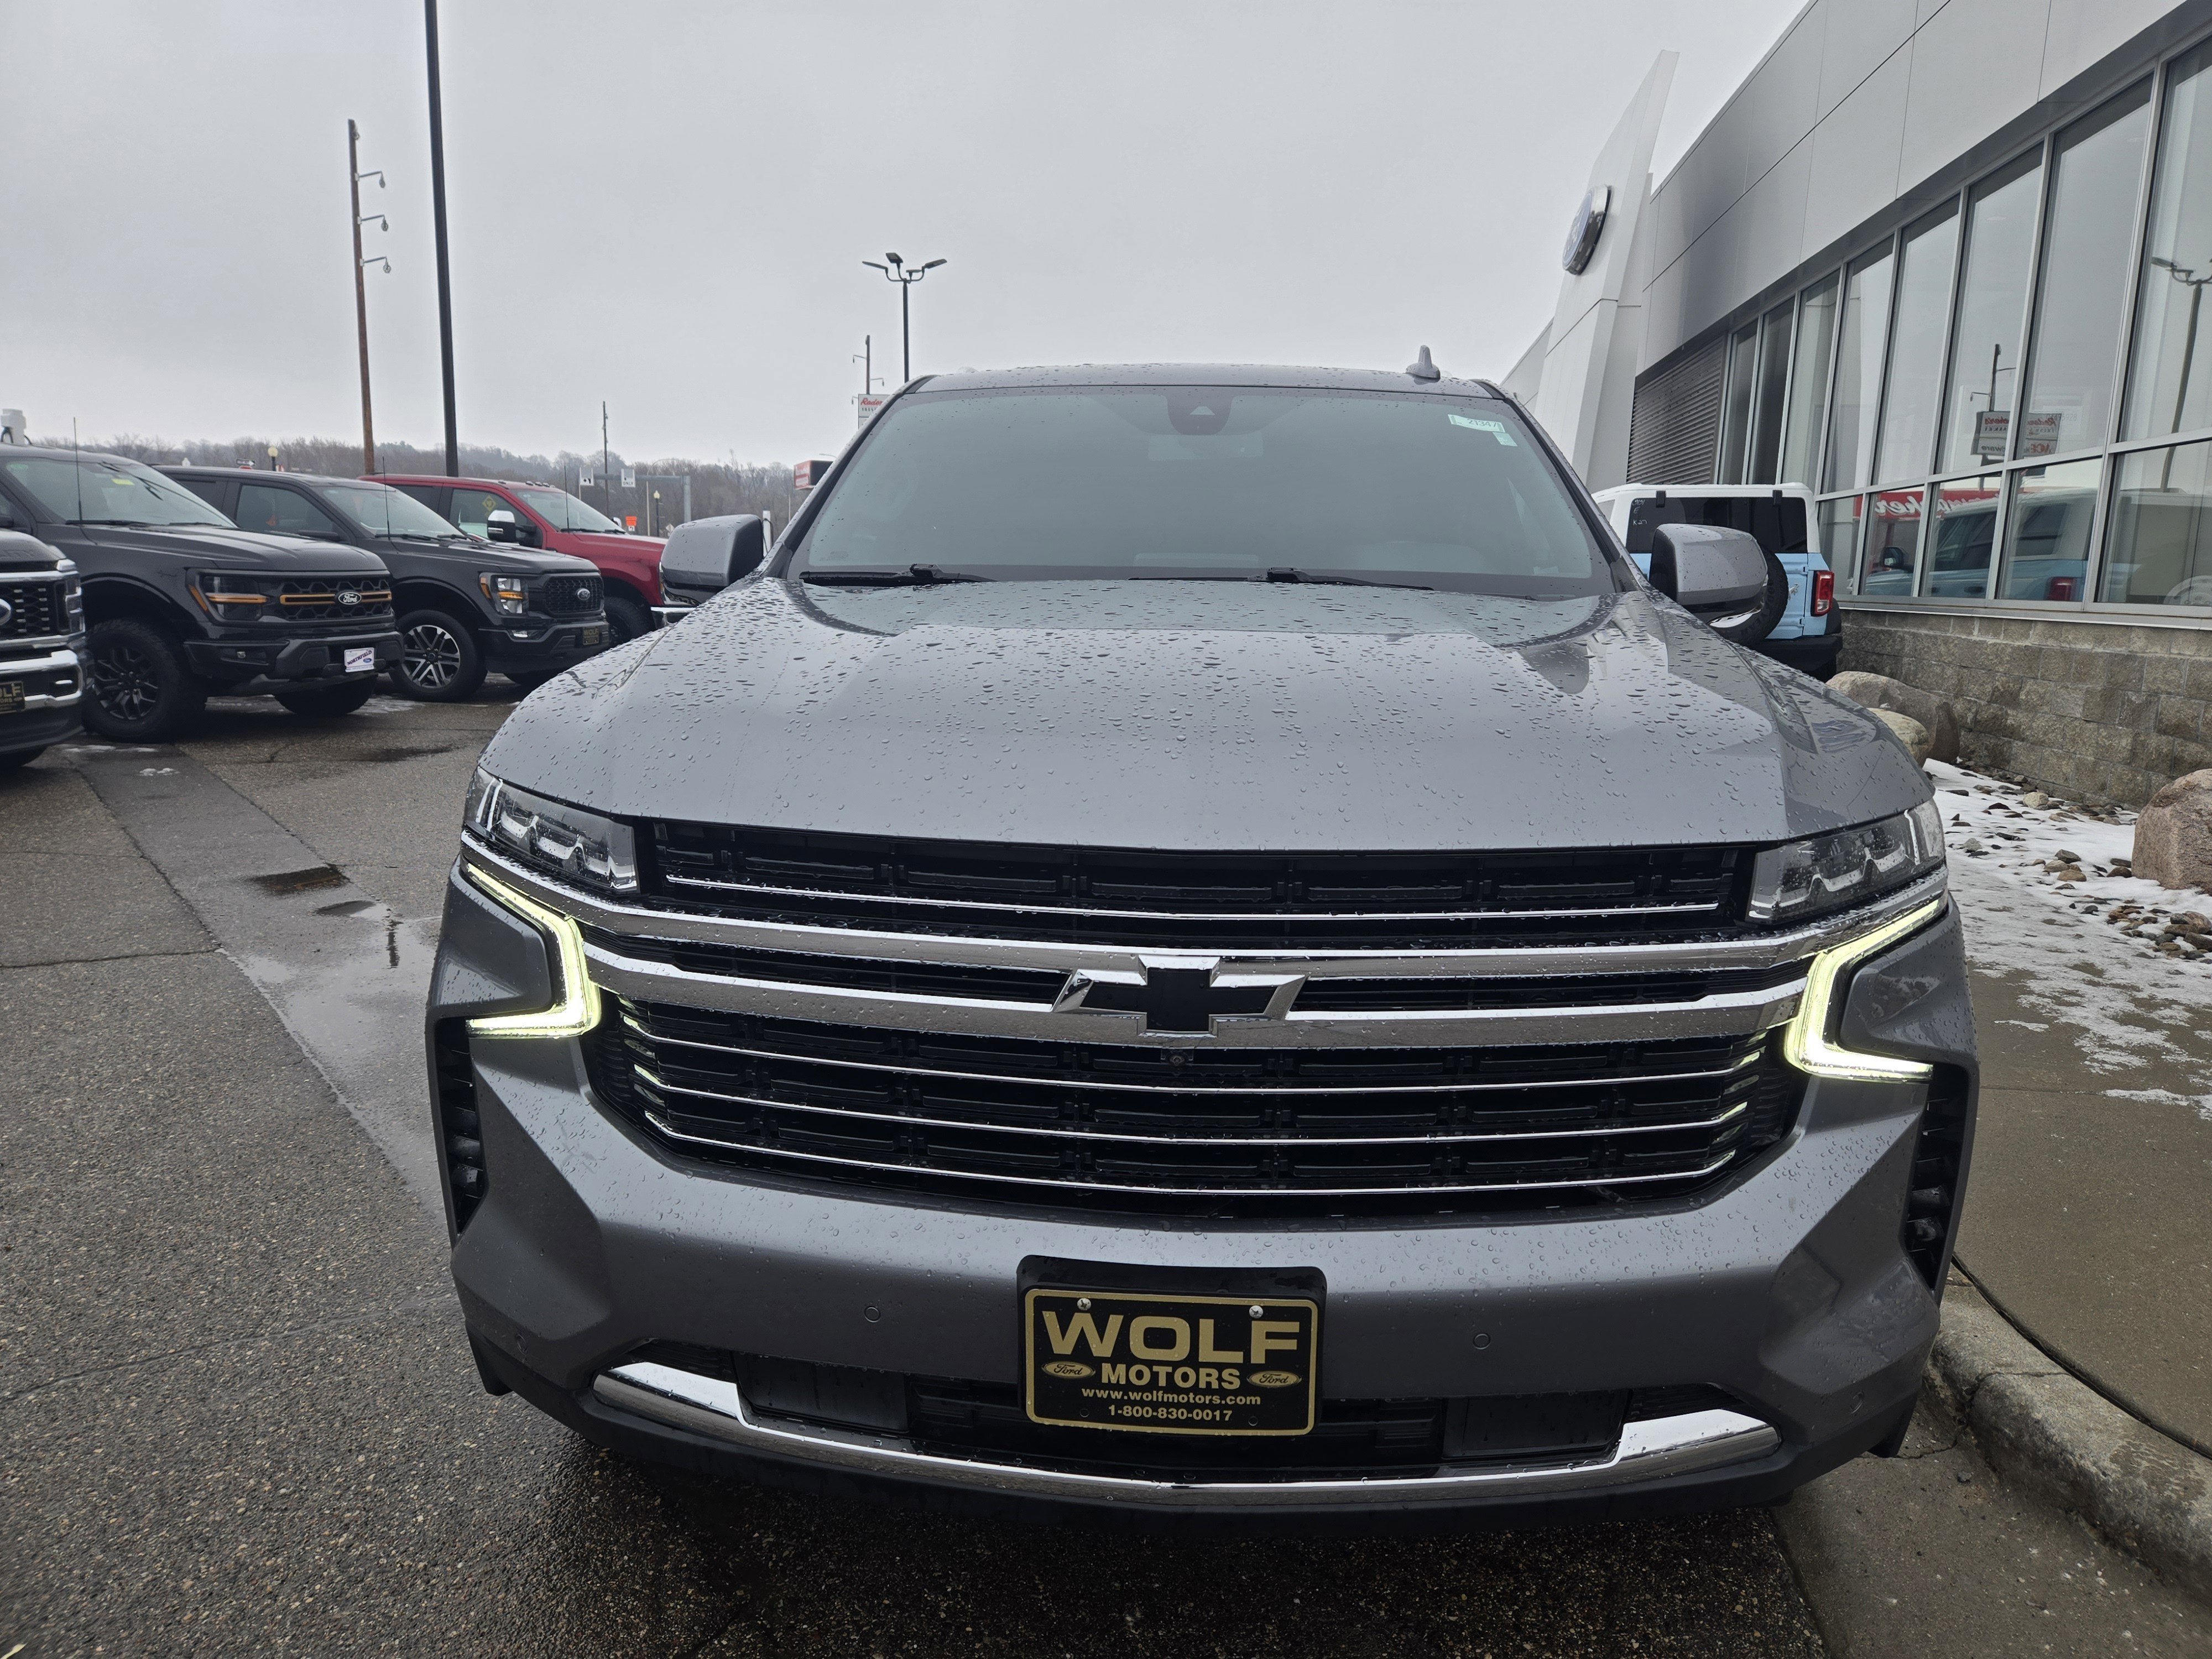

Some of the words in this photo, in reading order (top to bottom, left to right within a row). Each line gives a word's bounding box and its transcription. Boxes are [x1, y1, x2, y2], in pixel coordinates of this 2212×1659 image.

[343, 594, 357, 603] Ford
[347, 650, 372, 666] NORTHFIELD
[1042, 1311, 1300, 1364] WOLF
[1101, 1363, 1240, 1390] MOTORS
[1082, 1388, 1261, 1405] www.wolfmotors.com
[1108, 1405, 1233, 1421] 1-800-830-0017
